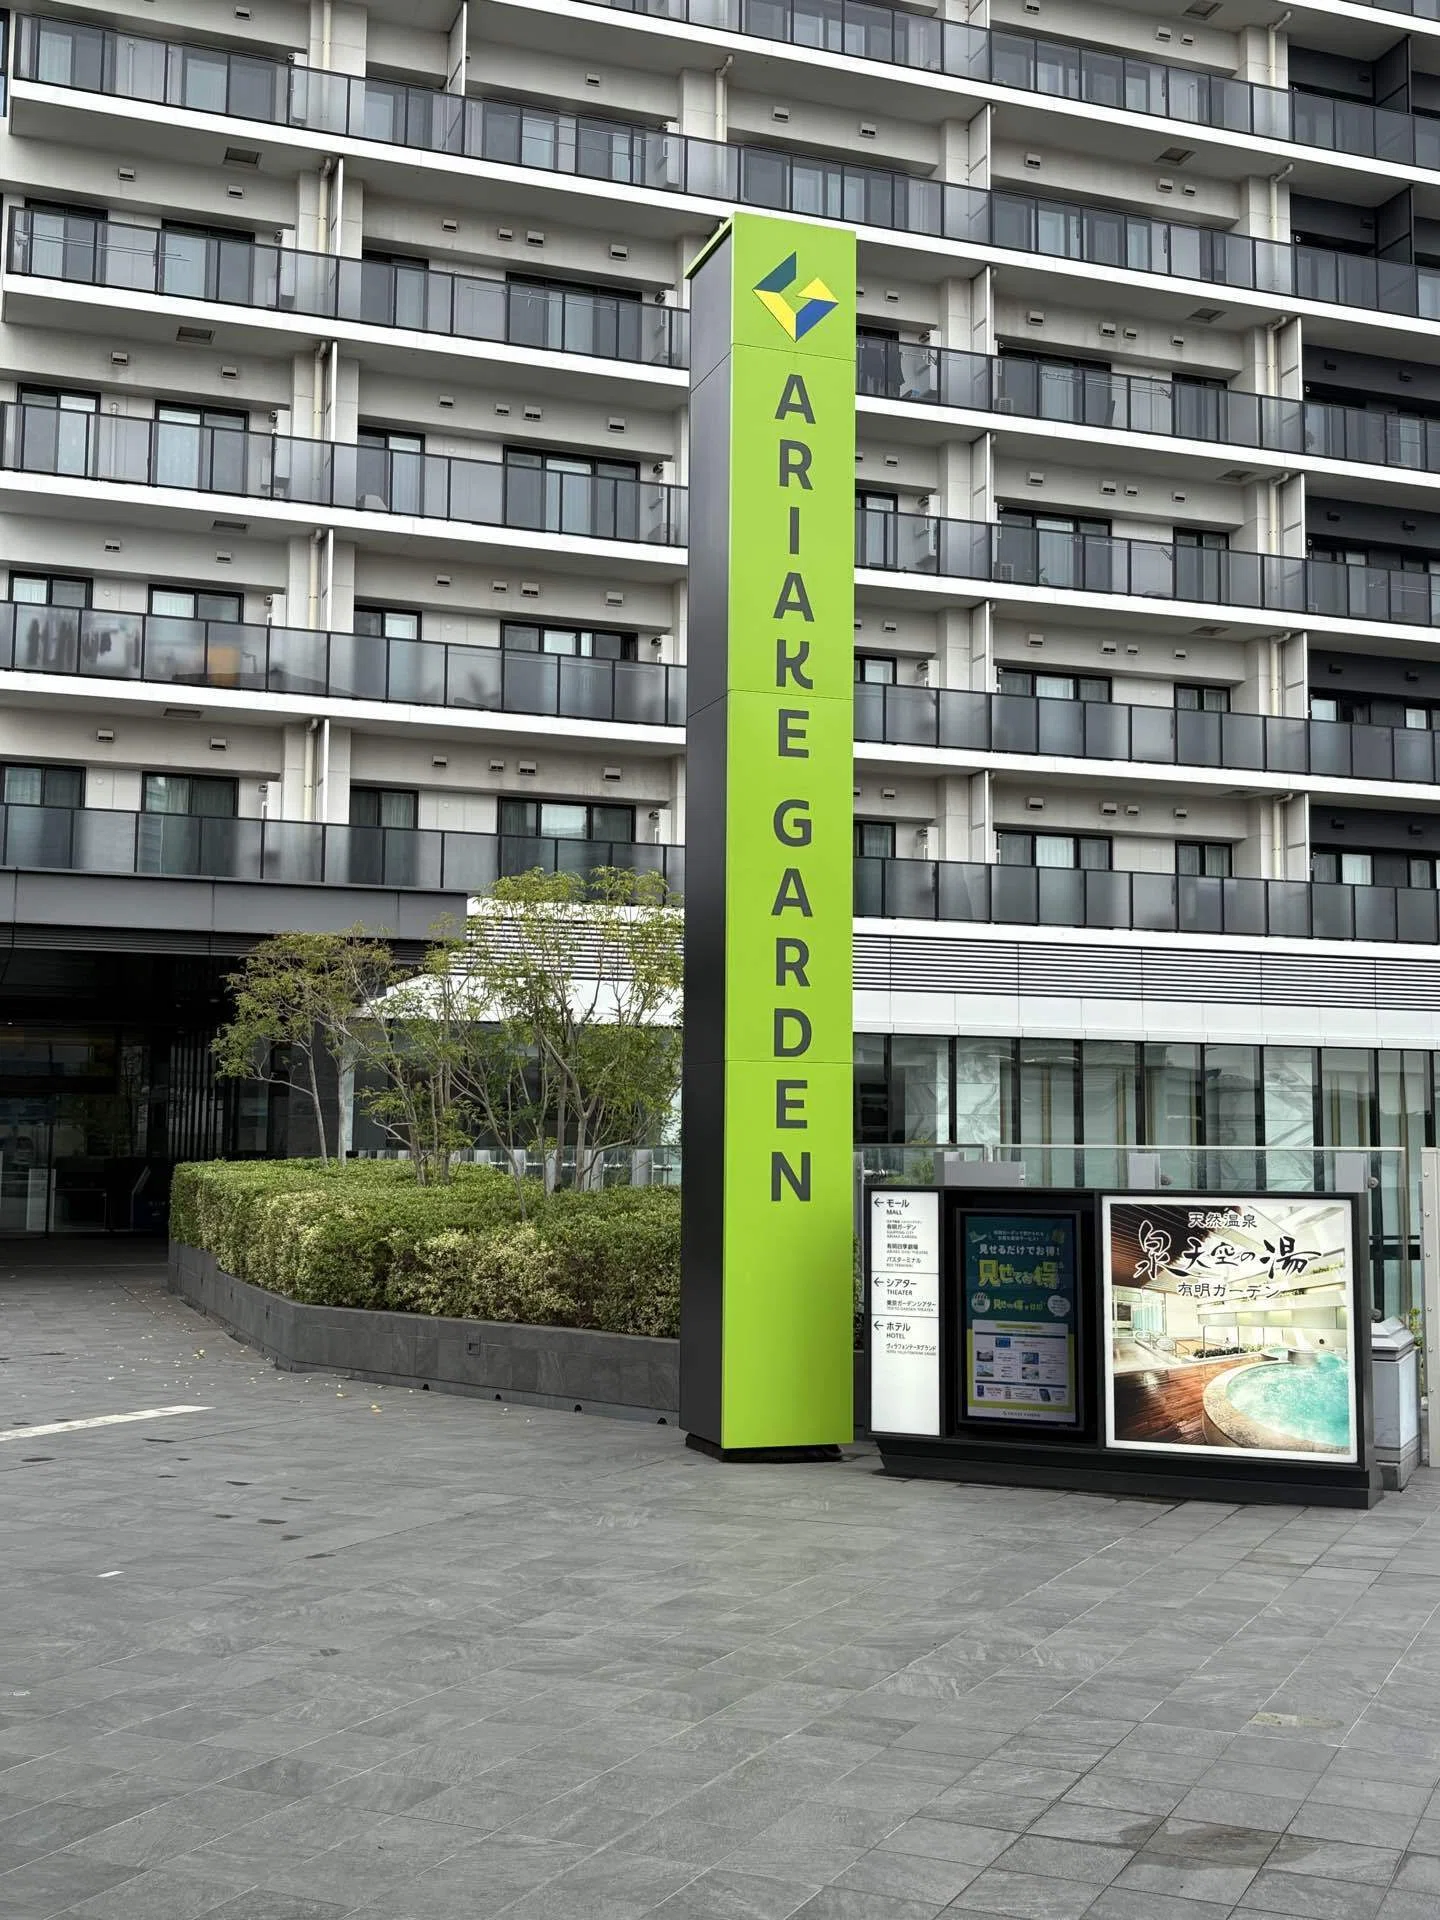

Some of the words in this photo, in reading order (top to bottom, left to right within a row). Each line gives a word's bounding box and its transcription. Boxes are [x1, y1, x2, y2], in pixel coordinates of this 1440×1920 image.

[772, 373, 817, 759] ARIAKE
[770, 798, 814, 1203] GARDEN
[886, 1199, 910, 1208] モール
[1188, 1212, 1257, 1229] 天然温泉
[886, 1279, 917, 1288] シアター
[1178, 1283, 1280, 1299] 有明ガーデン
[886, 1322, 911, 1332] ホテル
